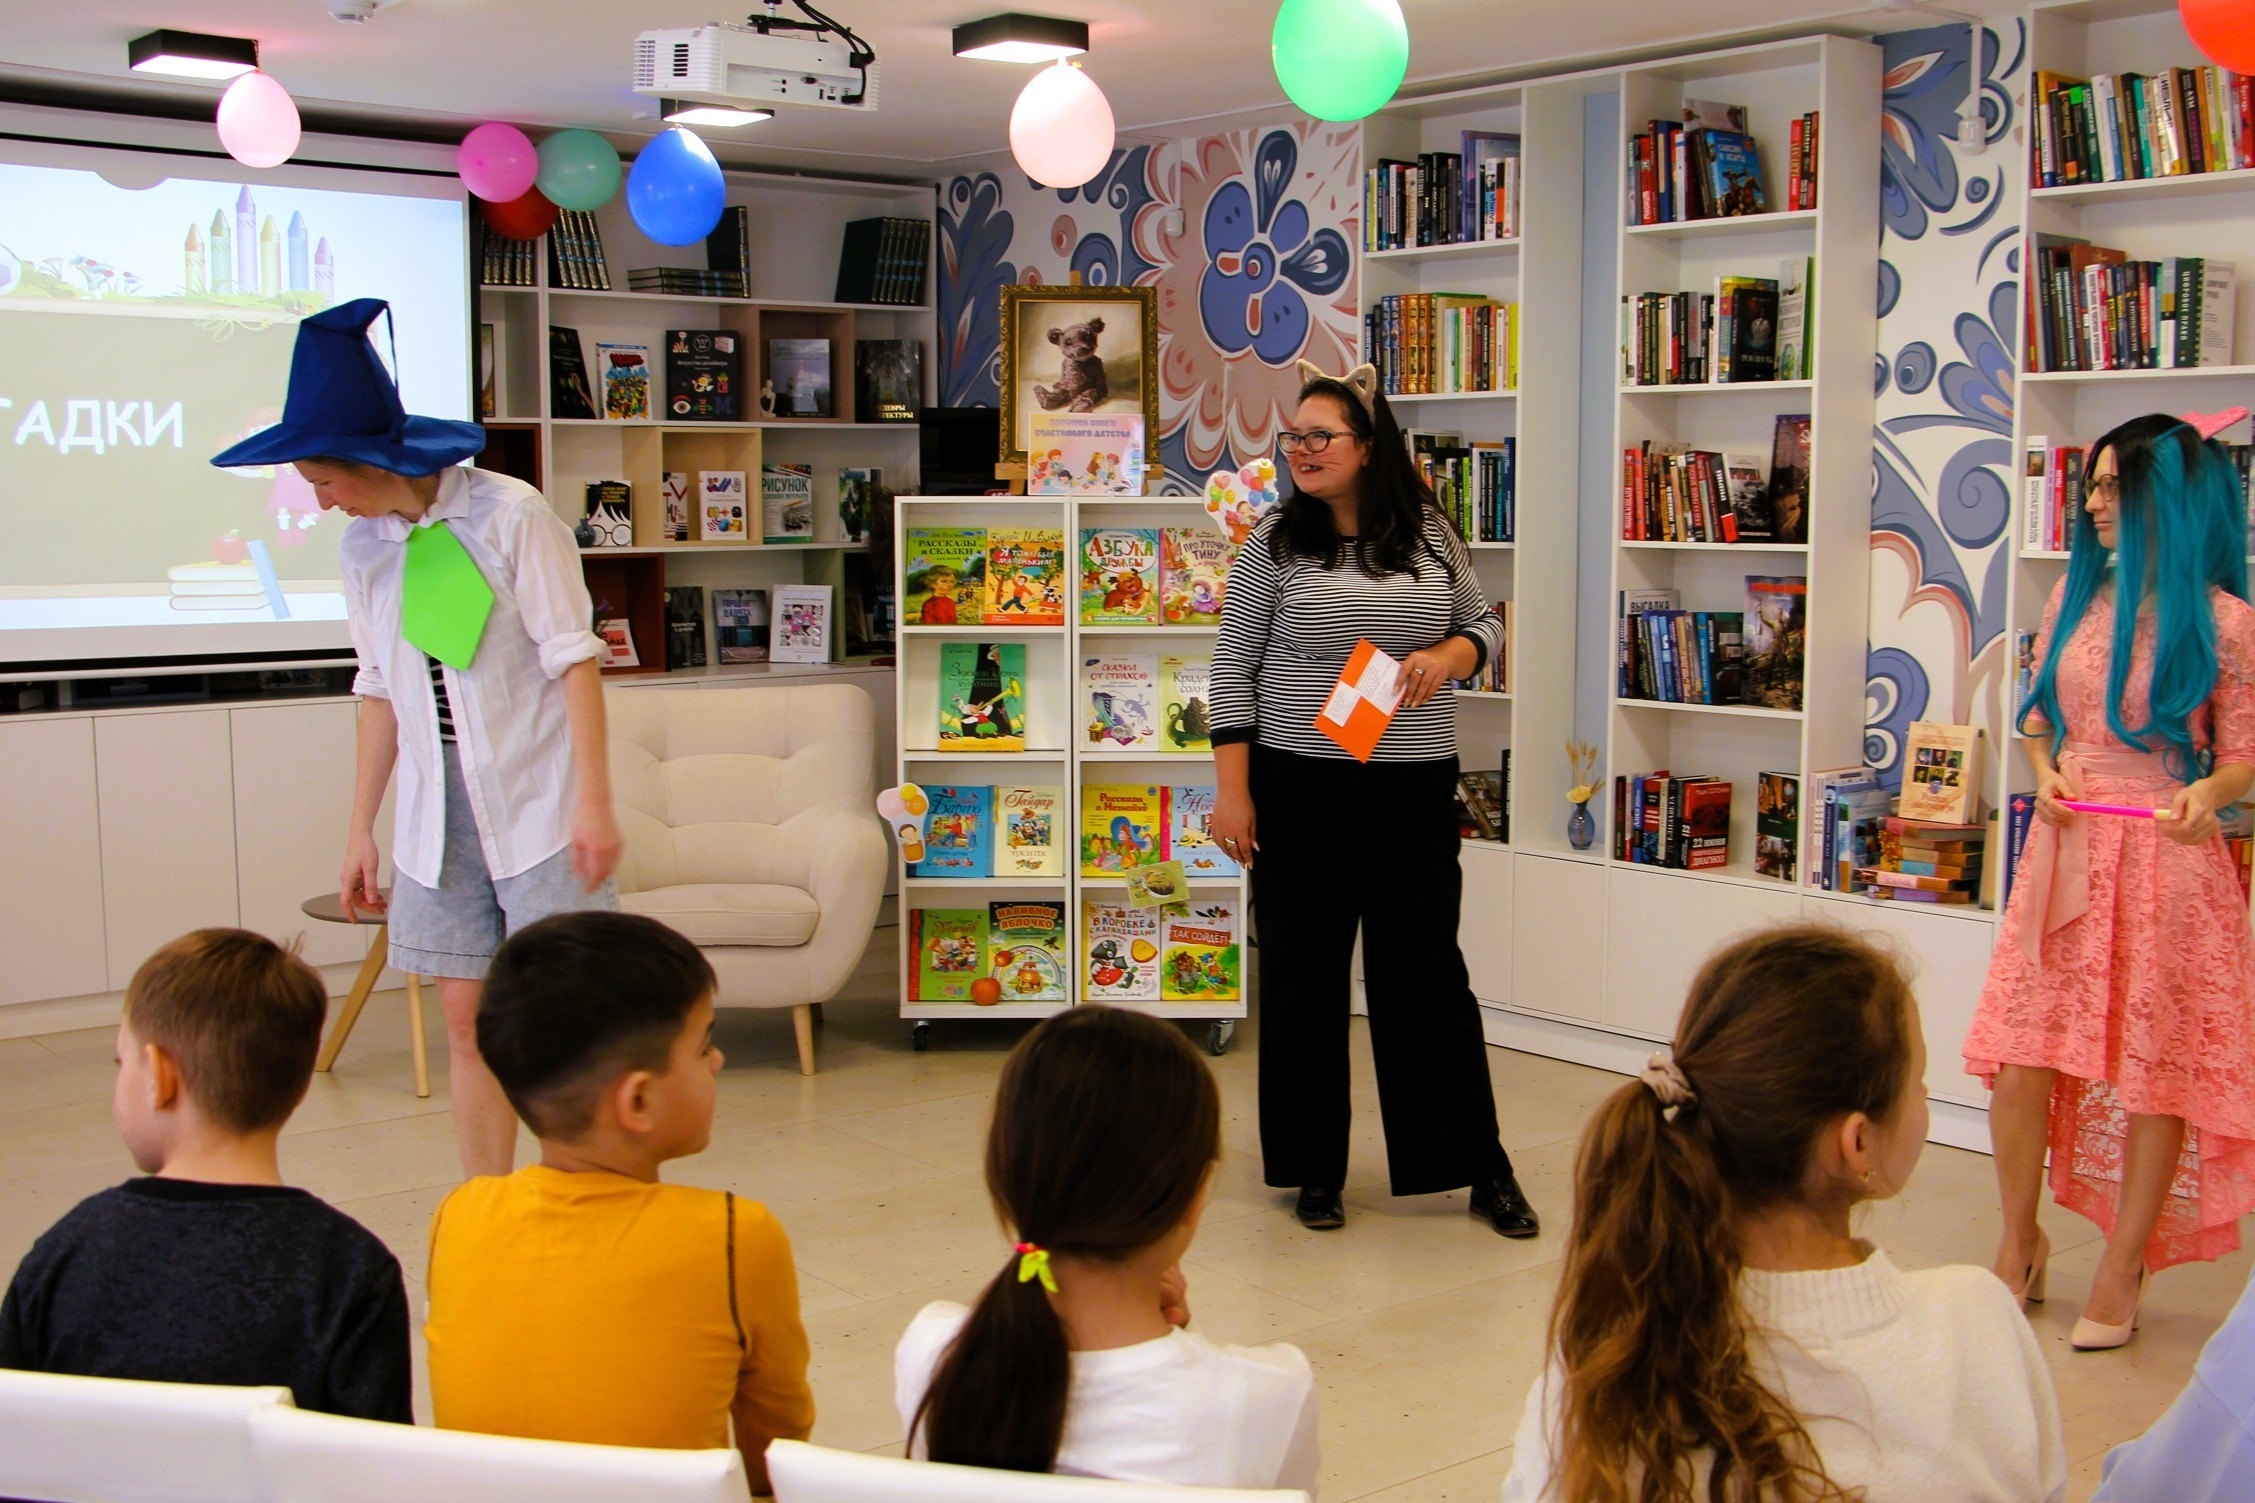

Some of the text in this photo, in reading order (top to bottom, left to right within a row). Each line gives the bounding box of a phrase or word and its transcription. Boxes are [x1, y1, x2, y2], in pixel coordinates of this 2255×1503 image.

[2180, 270, 2190, 341] ЦИФРОВОЕ ПРАВО
[0, 397, 184, 455] АДКИ
[762, 478, 809, 492] РИСУНОК
[918, 539, 977, 547] РАССКАЗЫ
[1089, 536, 1153, 557] АЗБУКА
[1183, 540, 1231, 551] ПРО УТОЧКУ
[1000, 545, 1011, 556] Я
[1192, 550, 1222, 560] ТИНУ
[1101, 557, 1144, 568] ДРУЖБЫ
[1102, 663, 1137, 671] СКАЗКИ
[1106, 672, 1148, 680] СТРАХОВ
[1173, 671, 1211, 683] Краден
[1004, 789, 1054, 810] Гайдар
[1100, 793, 1144, 802] Рассказы
[1177, 793, 1214, 813] Нос
[1104, 802, 1148, 811] Незнайке
[1692, 838, 1703, 848] 22
[996, 905, 1058, 918] НАЛИВНОЕ
[1000, 918, 1055, 930] ЯБЛОЧКО
[1093, 917, 1145, 928] В КОРОБКЕ
[1095, 926, 1156, 936] КАРАНДАШАМИ
[1172, 929, 1189, 939] ТАК
